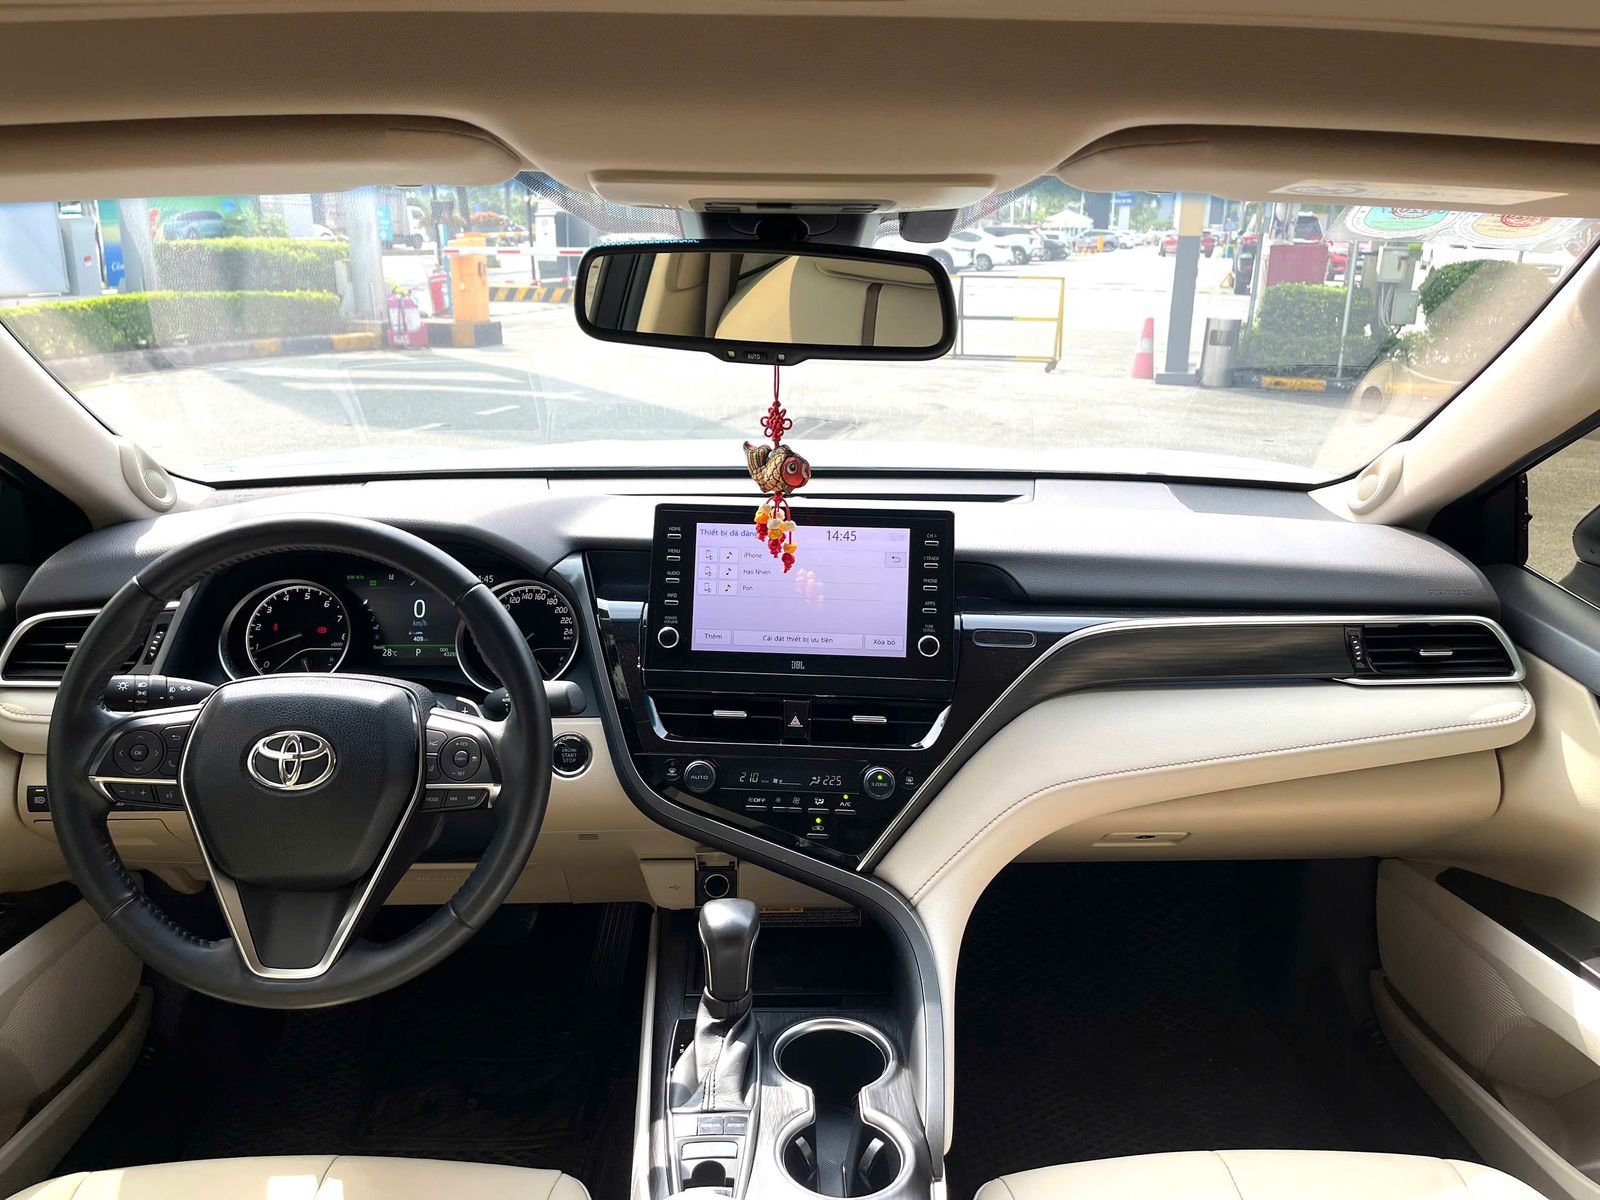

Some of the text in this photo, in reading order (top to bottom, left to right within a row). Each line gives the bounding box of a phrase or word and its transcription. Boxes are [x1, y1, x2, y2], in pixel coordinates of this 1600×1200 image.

[826, 530, 857, 541] 14:45
[304, 592, 311, 600] 5
[323, 600, 330, 608] 6
[413, 599, 426, 618] 0
[554, 606, 568, 614] 200
[336, 615, 343, 623] 7
[412, 619, 428, 627] km/h
[255, 623, 262, 631] 2
[415, 648, 421, 656] P
[791, 660, 805, 670] JBL
